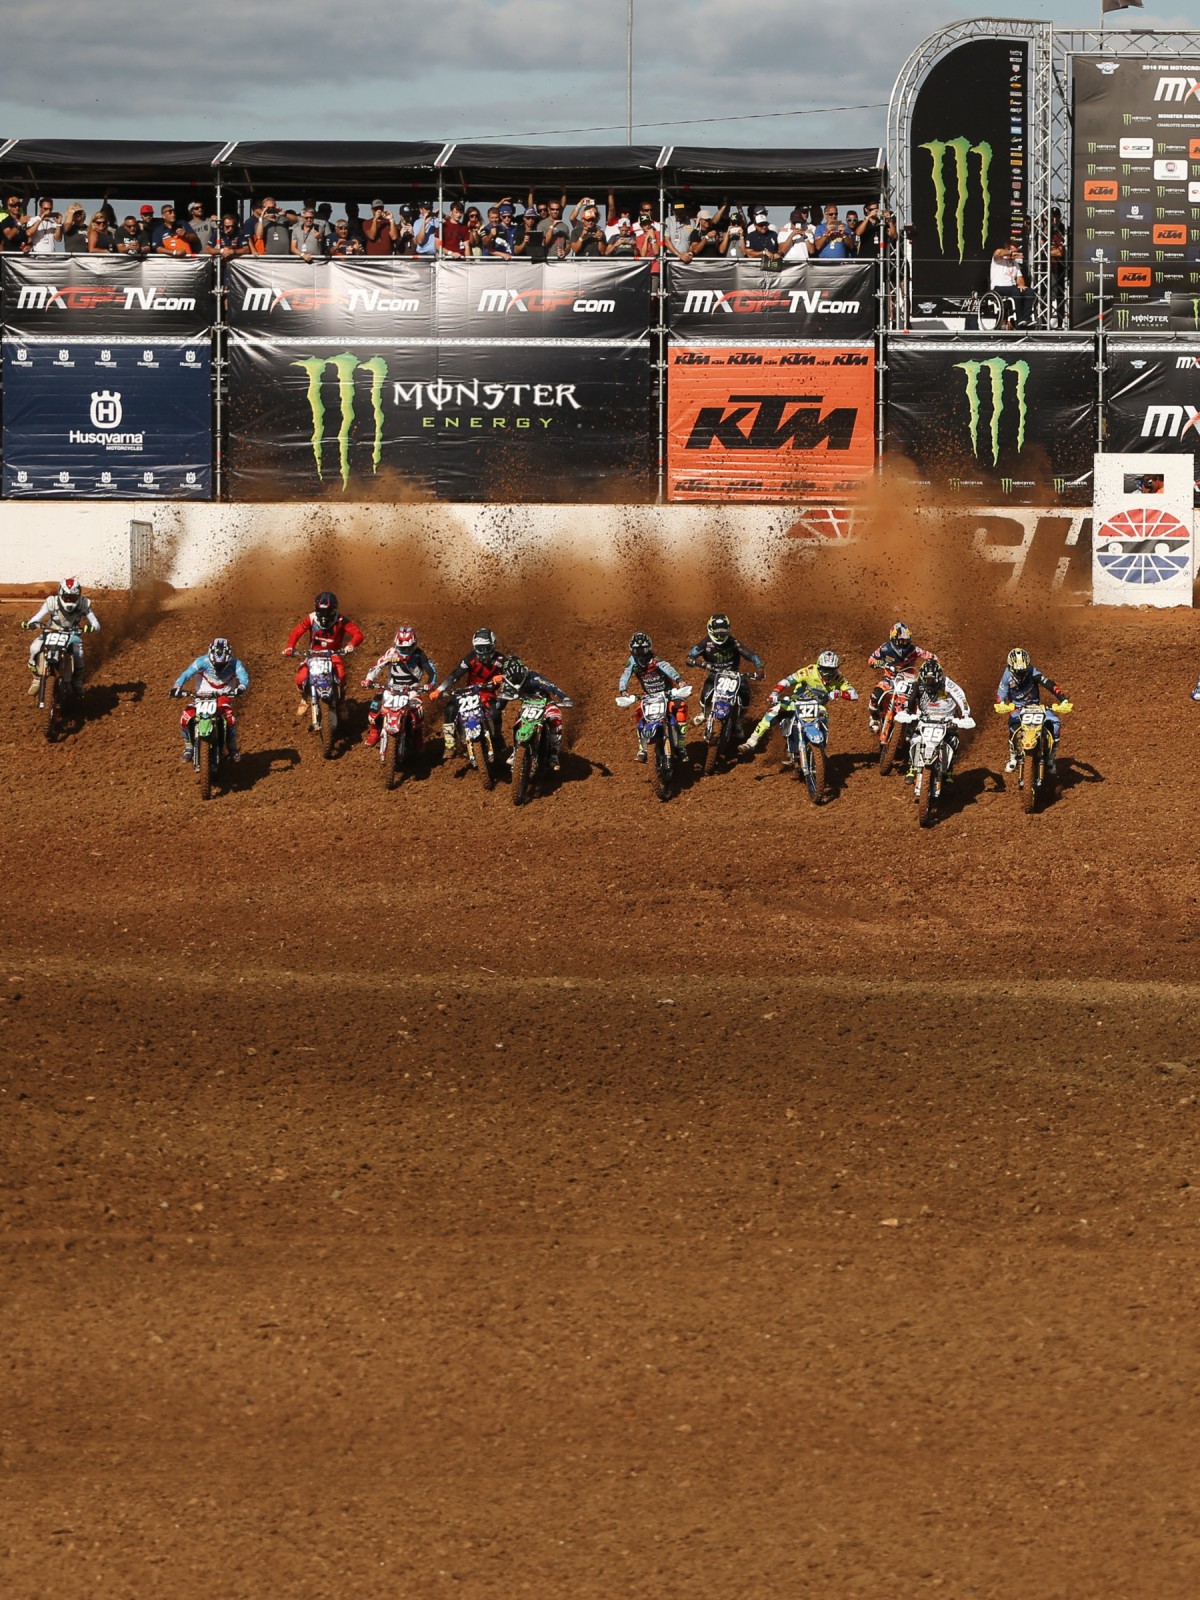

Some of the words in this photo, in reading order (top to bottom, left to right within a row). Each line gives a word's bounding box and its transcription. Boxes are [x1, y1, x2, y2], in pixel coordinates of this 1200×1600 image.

[1132, 315, 1168, 323] MONSTER
[392, 378, 582, 411] MONSTER
[422, 417, 553, 428] ENERGY
[684, 395, 858, 450] KTM
[69, 430, 144, 446] Husqvarna
[44, 633, 69, 646] 199
[195, 701, 217, 714] 140
[384, 695, 408, 708] 216
[458, 695, 480, 712] 232
[521, 708, 544, 720] 457
[644, 702, 665, 715] 161
[799, 704, 818, 718] 321
[1022, 713, 1044, 724] 98
[923, 728, 942, 741] 99
